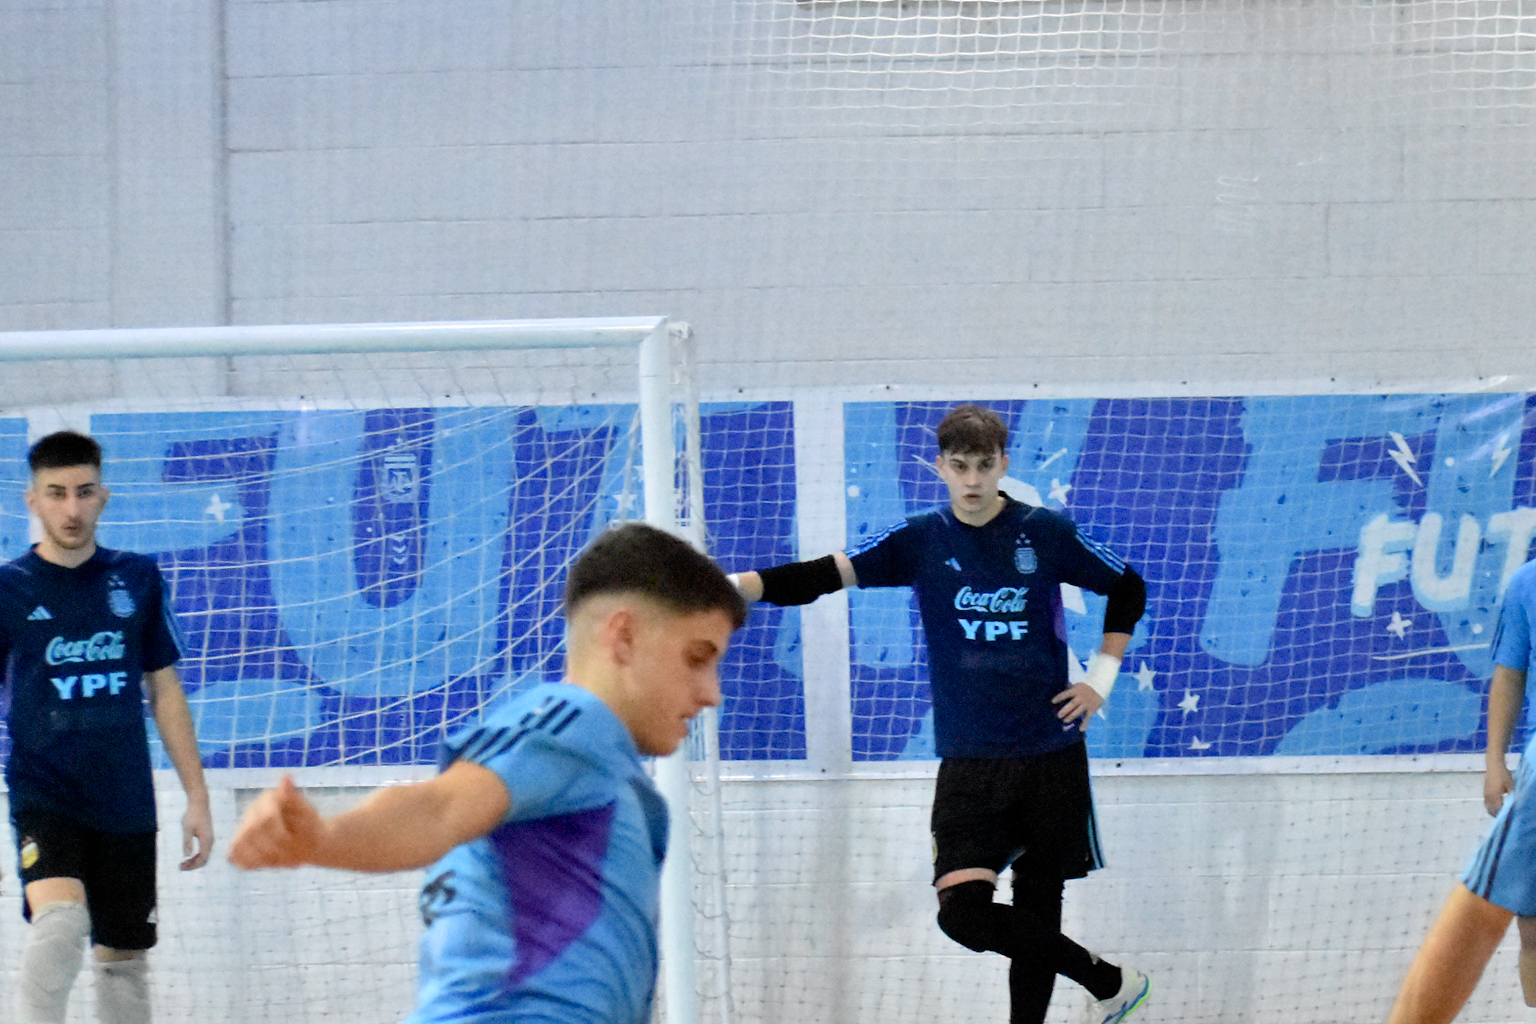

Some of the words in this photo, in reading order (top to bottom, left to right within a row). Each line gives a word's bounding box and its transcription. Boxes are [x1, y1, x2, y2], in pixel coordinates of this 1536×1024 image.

[954, 585, 1030, 613] Coca-Cola
[958, 618, 1029, 642] YPF
[51, 671, 128, 700] YPF
